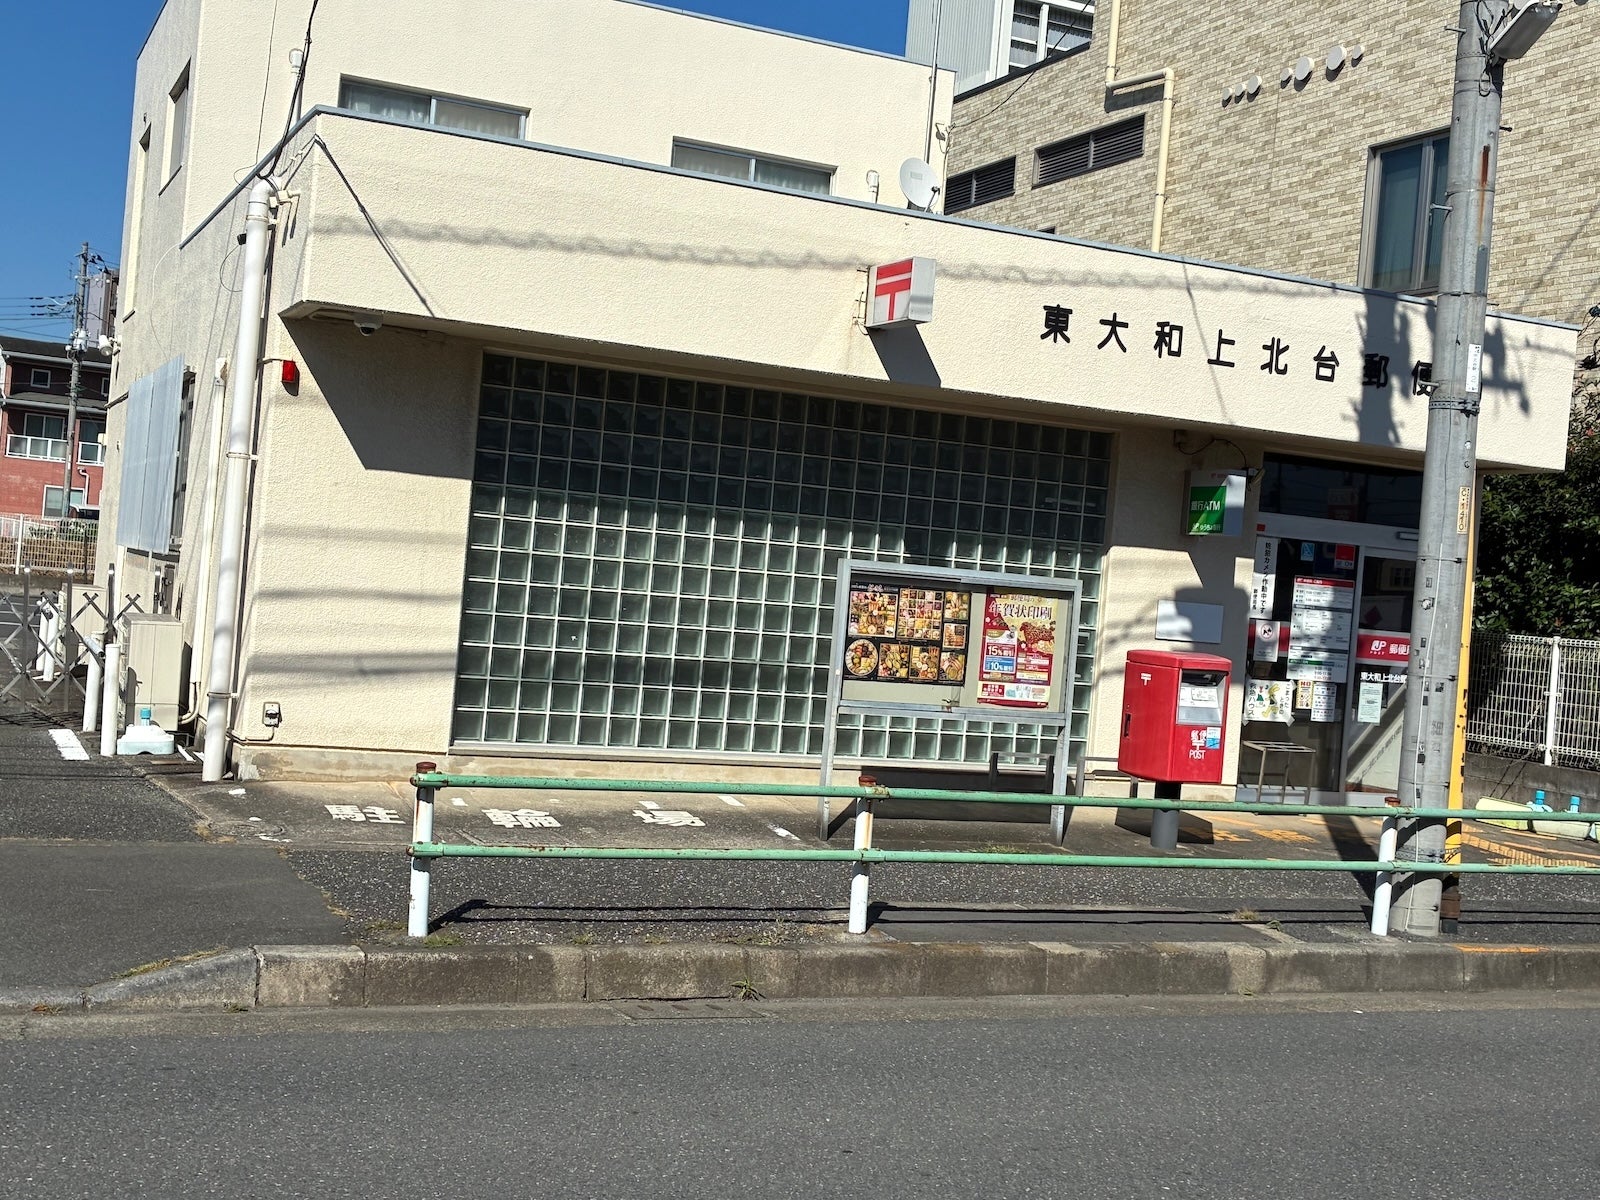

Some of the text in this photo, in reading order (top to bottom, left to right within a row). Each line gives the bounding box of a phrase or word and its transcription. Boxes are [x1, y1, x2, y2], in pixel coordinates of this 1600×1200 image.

[989, 601, 1053, 620] 年賀状印刷
[1389, 643, 1410, 655] 郵便
[1189, 750, 1206, 760] POST
